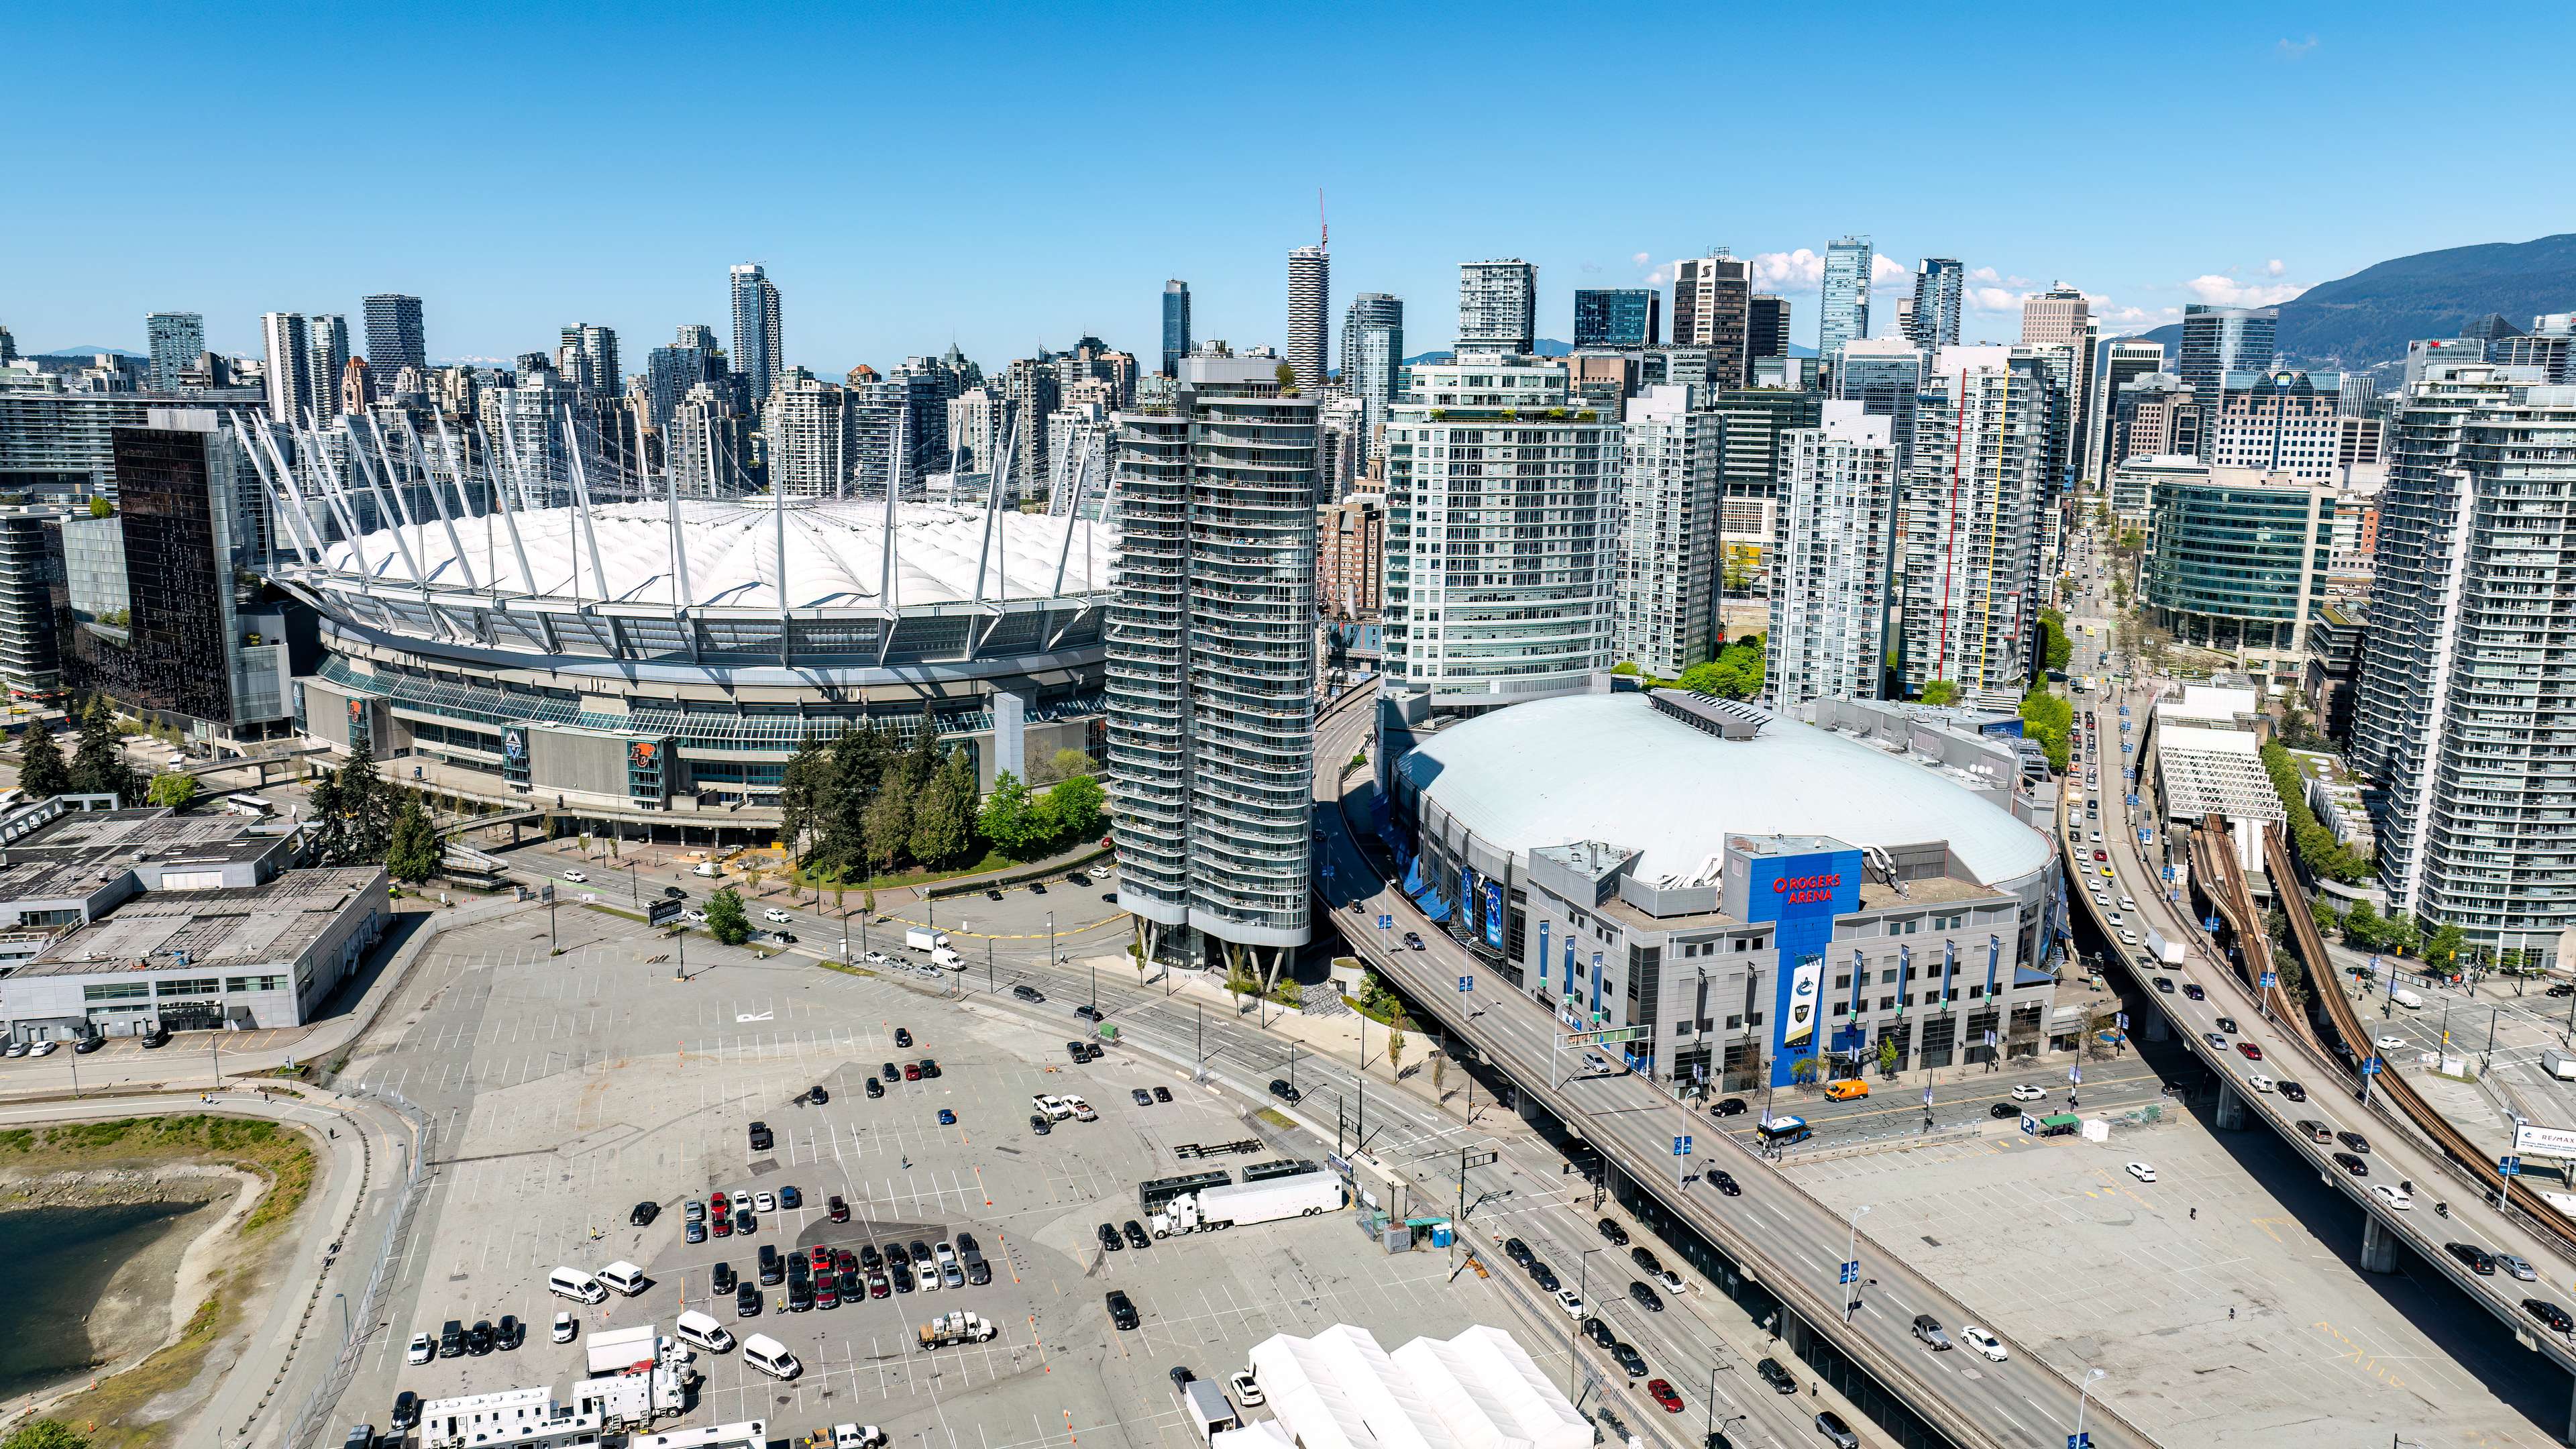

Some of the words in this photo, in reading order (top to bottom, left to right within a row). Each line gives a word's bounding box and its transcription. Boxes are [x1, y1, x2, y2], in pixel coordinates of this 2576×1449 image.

[1478, 872, 1485, 887] 7
[1789, 873, 1841, 891] ROGERS
[1788, 889, 1833, 905] ARENA
[2023, 1117, 2031, 1128] P
[2542, 1134, 2575, 1143] RE/MAX
